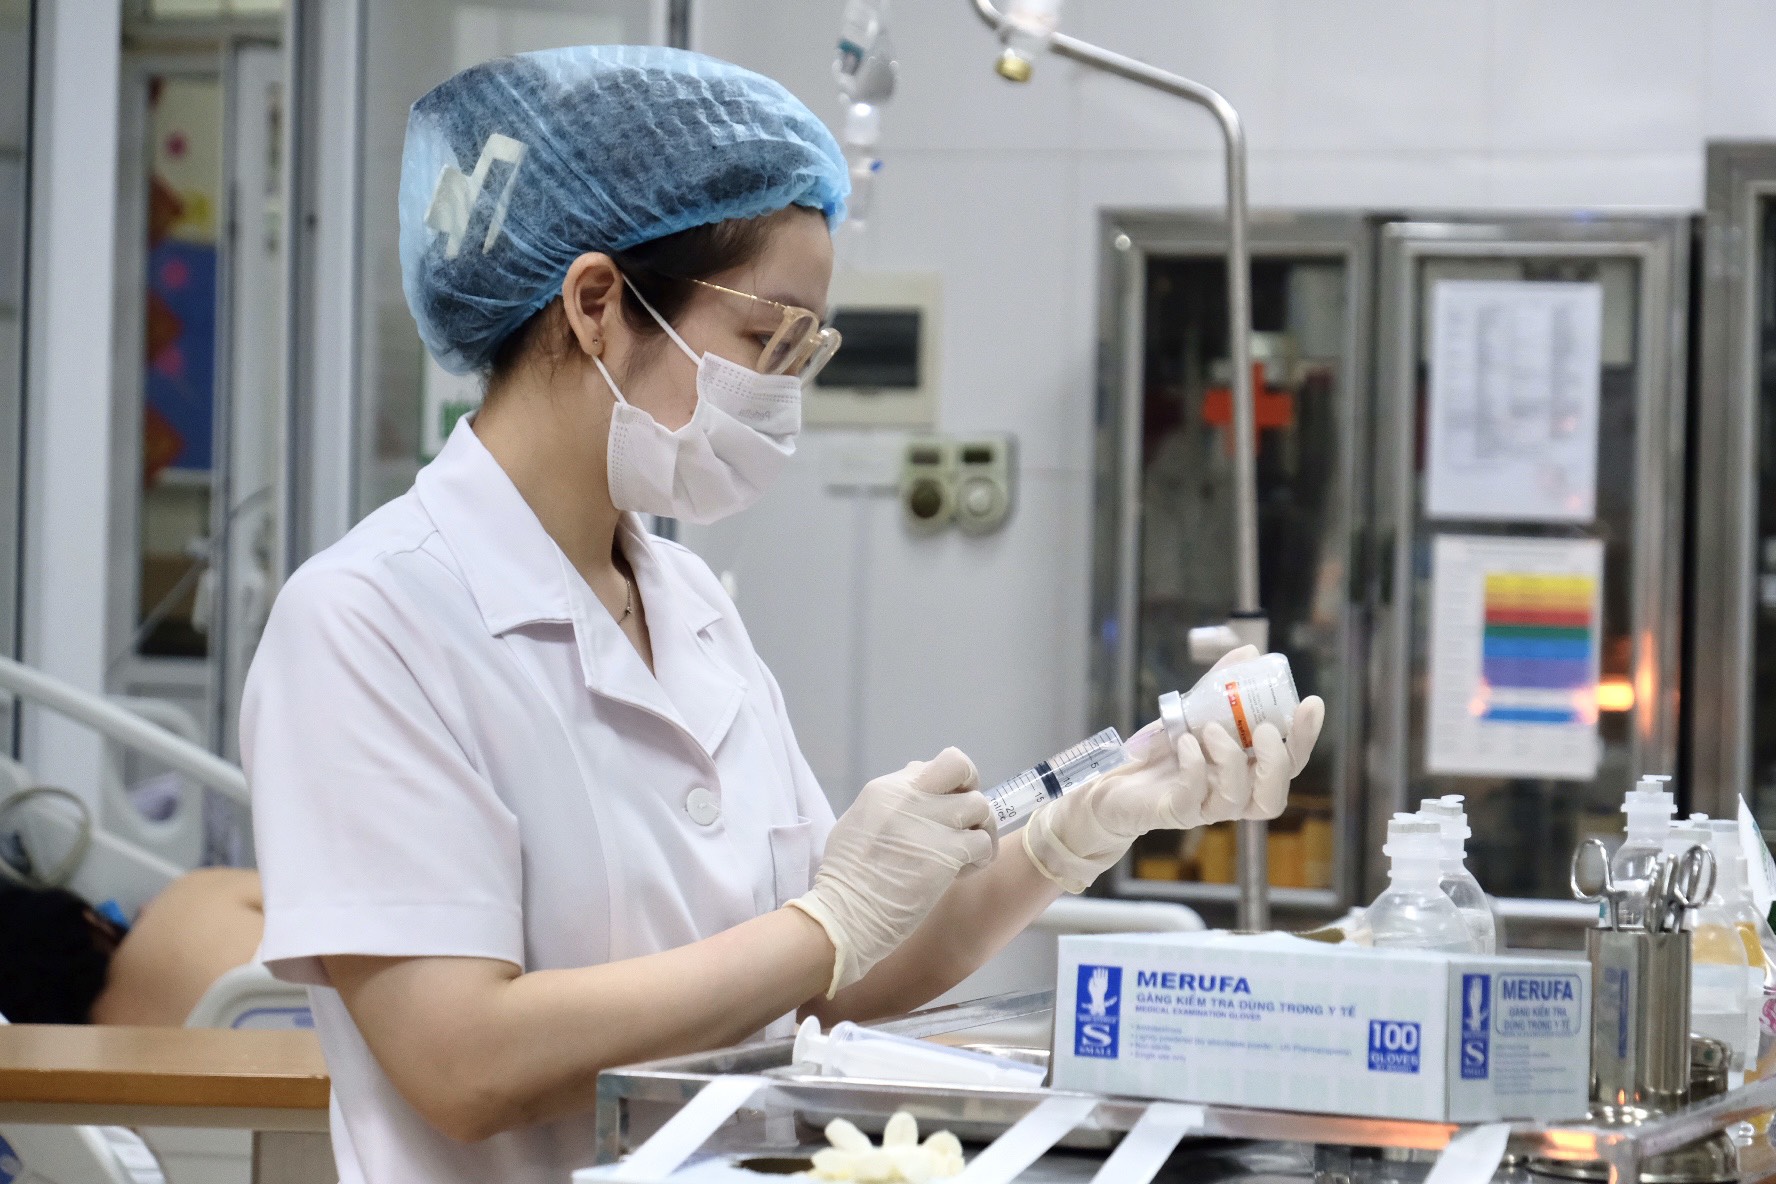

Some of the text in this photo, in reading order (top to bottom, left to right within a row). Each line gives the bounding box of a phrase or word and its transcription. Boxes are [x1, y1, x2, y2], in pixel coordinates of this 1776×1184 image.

[1090, 761, 1099, 769] 5
[1063, 776, 1073, 788] 10
[1034, 792, 1045, 803] 15
[1005, 805, 1017, 818] 20
[1137, 970, 1251, 994] MERUFA
[1503, 980, 1573, 1001] MERUFA
[1211, 998, 1235, 1010] TRA
[1280, 1001, 1324, 1016] TRONG
[1329, 1006, 1336, 1016] Y
[1082, 1024, 1112, 1047] S
[1373, 1023, 1418, 1052] 100
[1465, 1041, 1485, 1067] S
